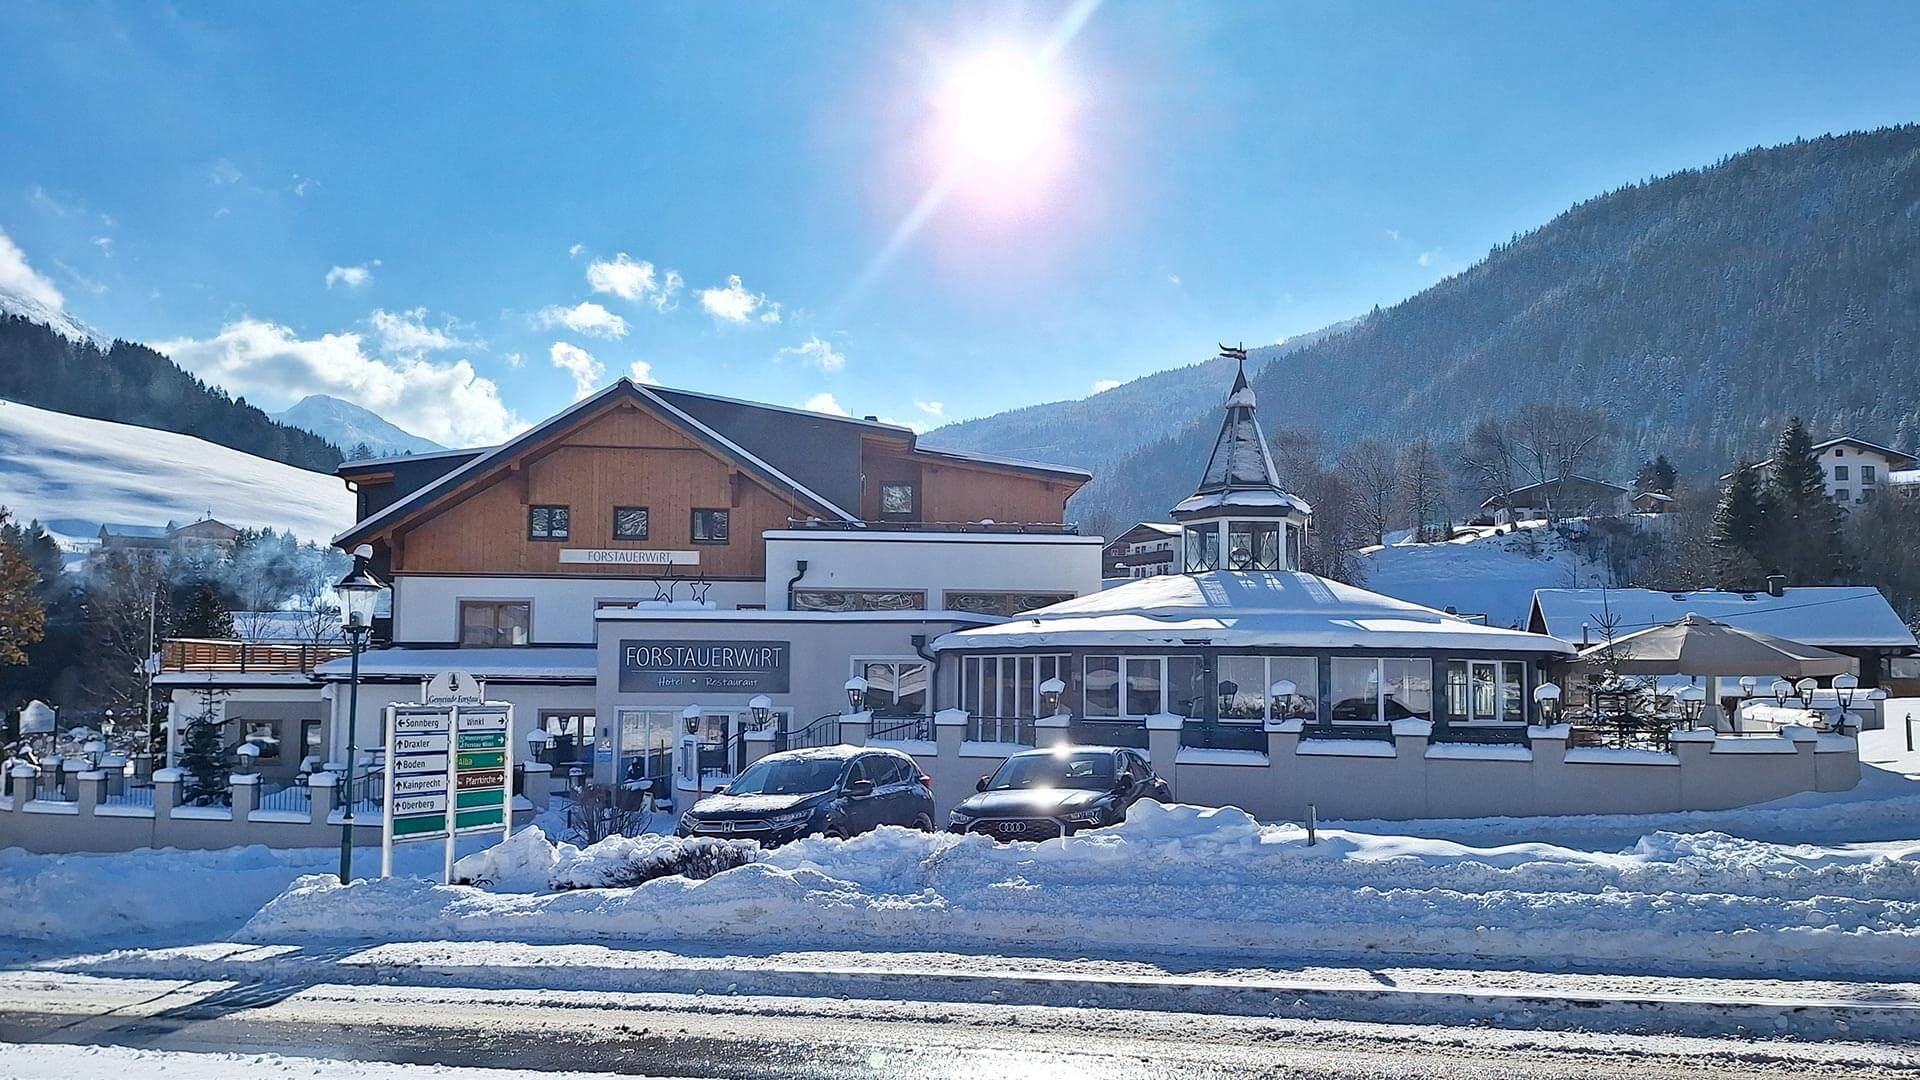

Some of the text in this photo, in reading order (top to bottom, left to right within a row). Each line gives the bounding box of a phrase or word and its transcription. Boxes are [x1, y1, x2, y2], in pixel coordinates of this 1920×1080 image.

[626, 647, 782, 667] FORSTAUERWiRT
[657, 675, 758, 687] Hotel Restaurant
[406, 719, 439, 728] Sonnberg
[466, 718, 485, 726] Winkl
[404, 740, 430, 749] Draxler
[403, 760, 426, 768] Boden
[403, 780, 441, 790] Kainprecht
[465, 777, 496, 785] Pfarrkirche
[402, 800, 435, 810] Oberberg
